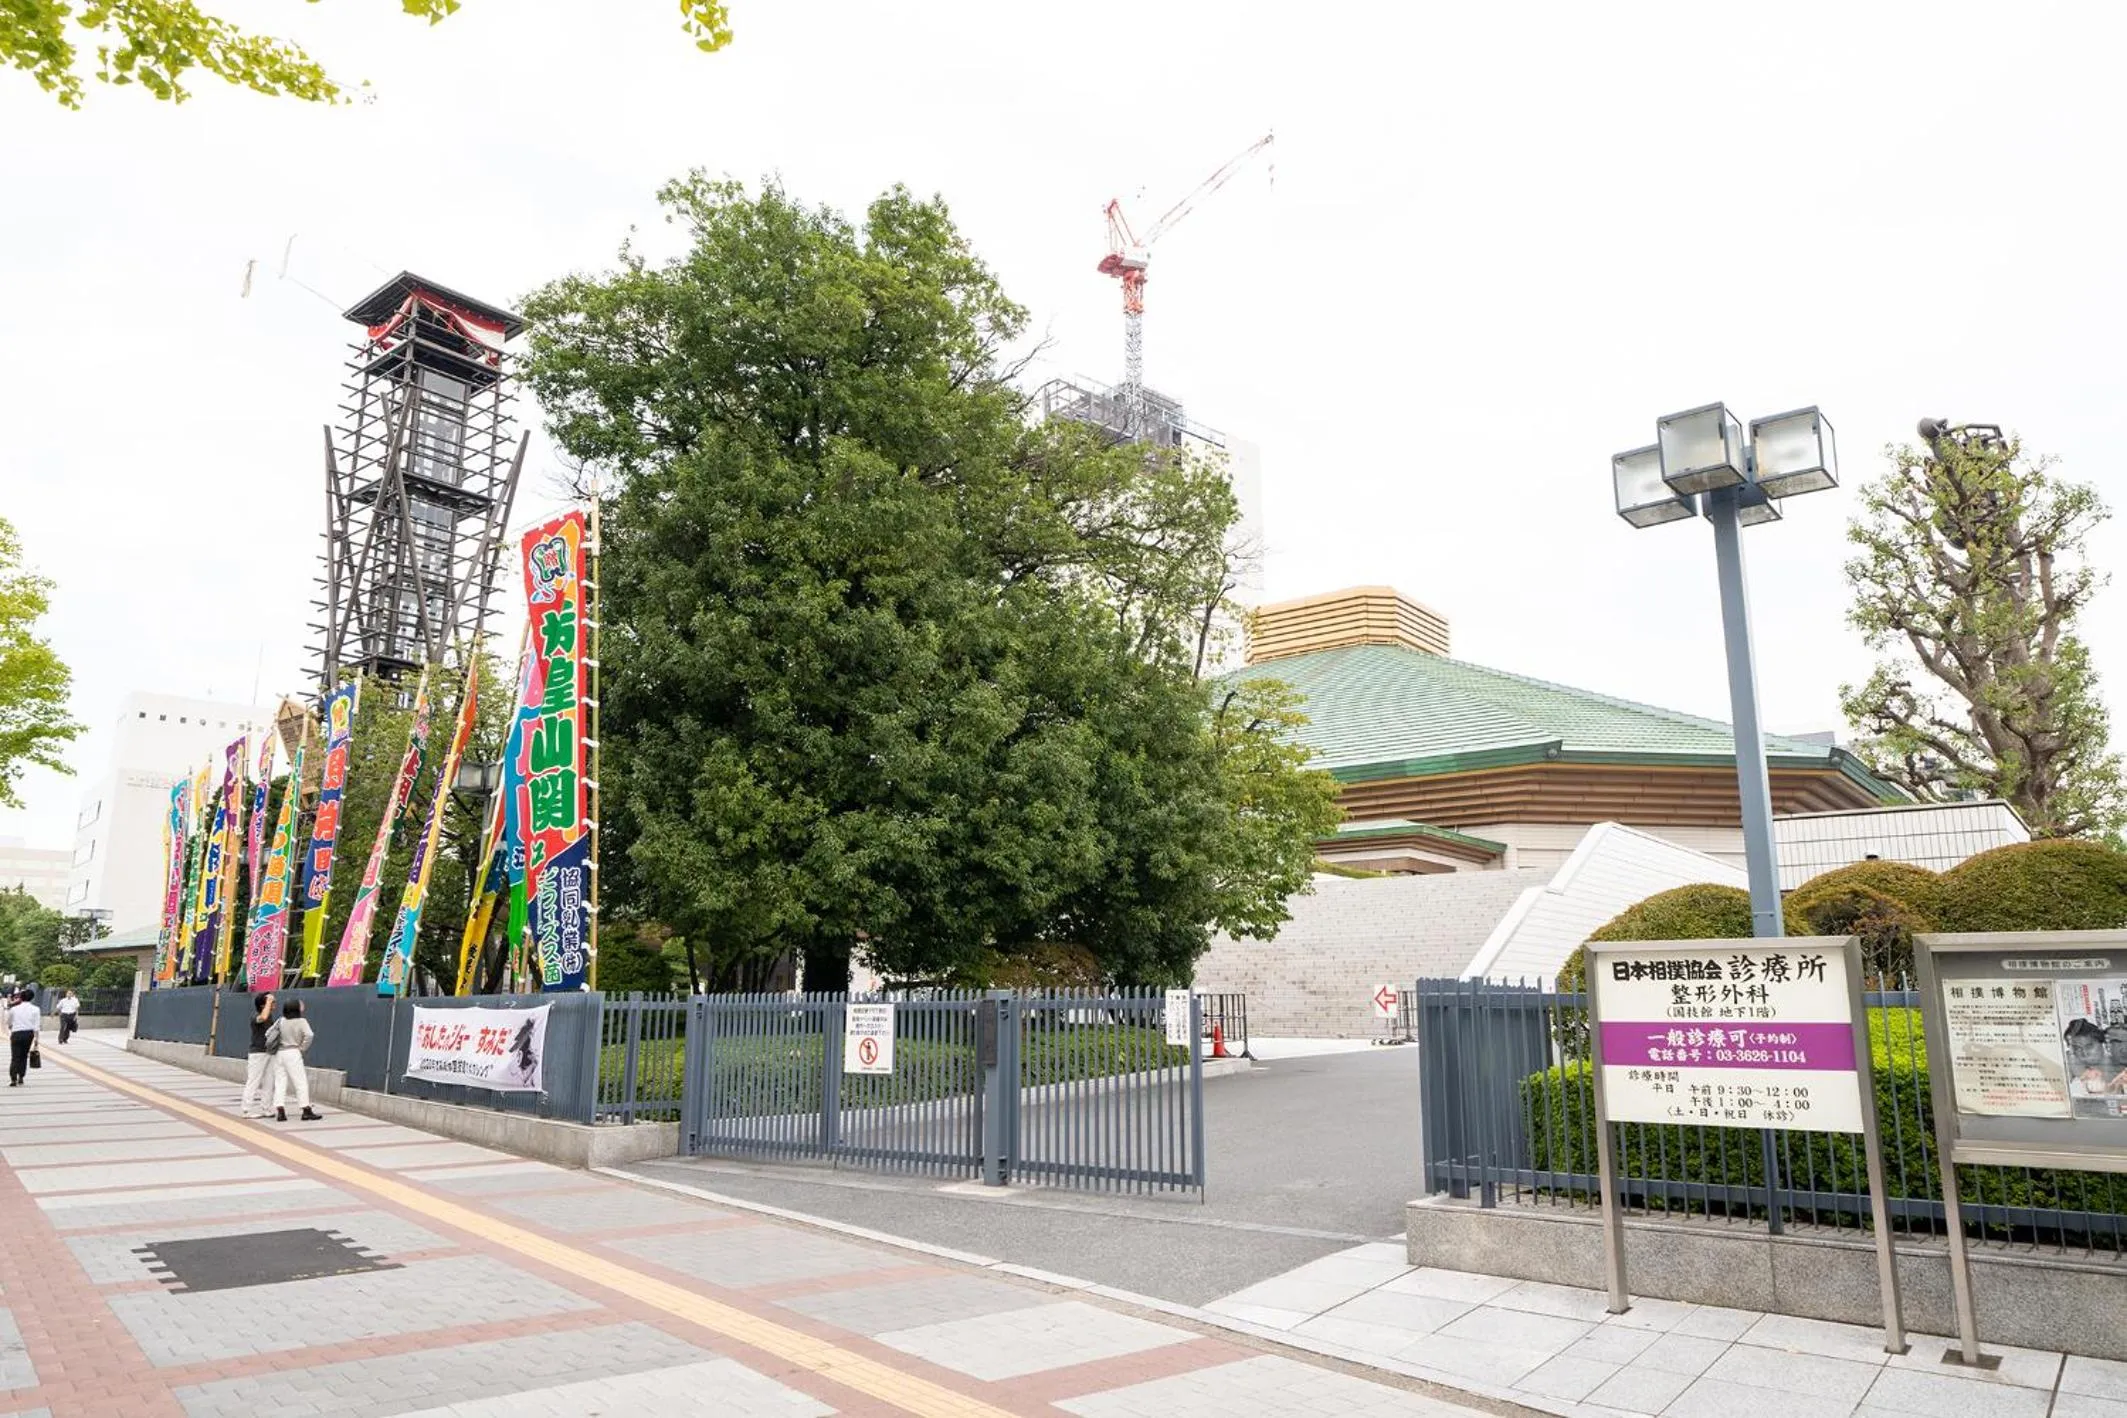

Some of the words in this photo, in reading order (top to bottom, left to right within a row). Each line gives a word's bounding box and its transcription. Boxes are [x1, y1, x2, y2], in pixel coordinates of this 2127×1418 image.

[1671, 983, 1770, 1005] 整形外科
[1951, 986, 2049, 999] 相撲博物館
[1628, 1070, 1680, 1082] 診療時間
[1652, 1084, 1675, 1094] 平日
[1688, 1085, 1711, 1095] 午前
[1690, 1097, 1713, 1107] 午後
